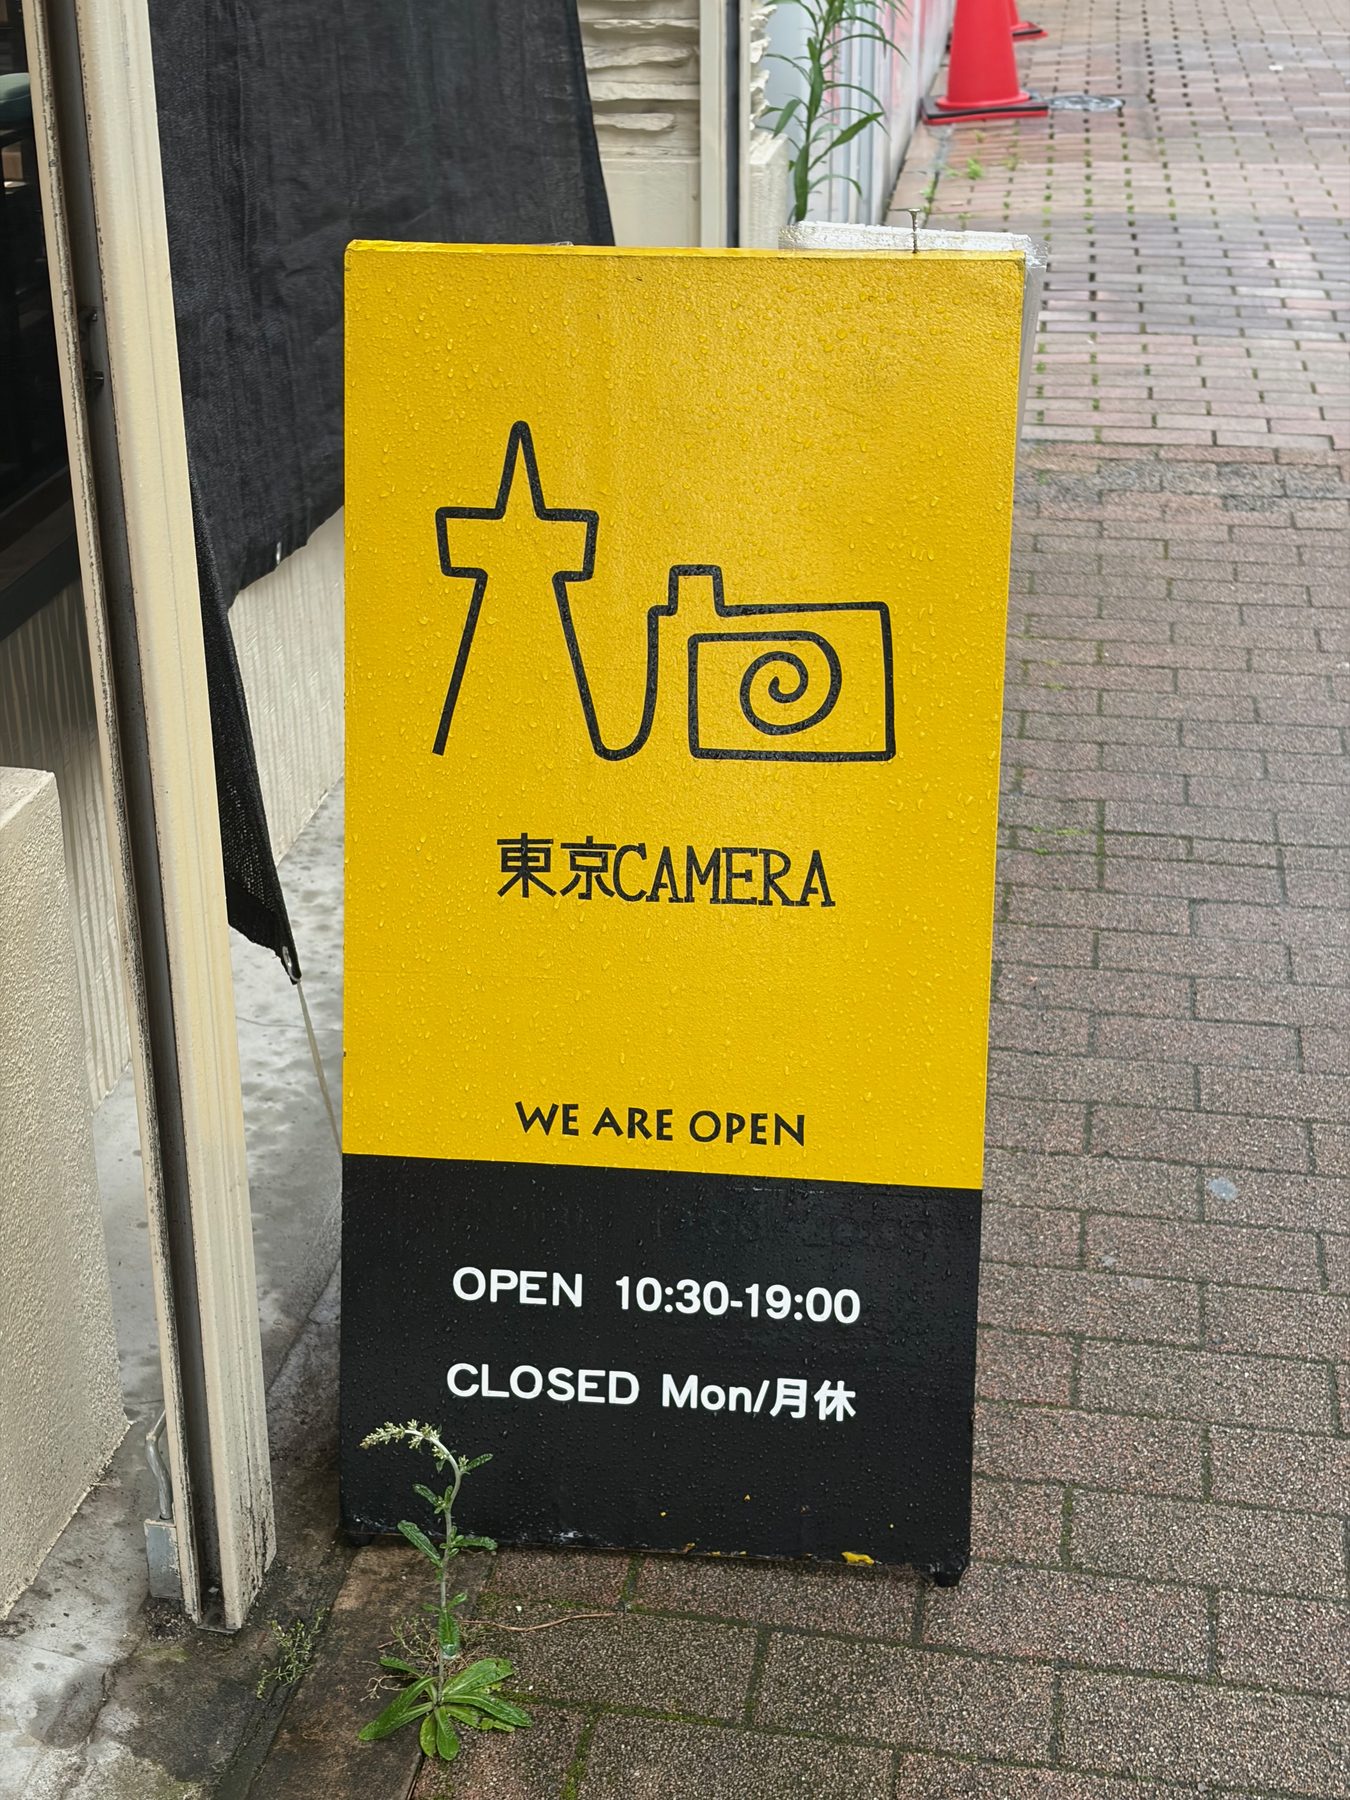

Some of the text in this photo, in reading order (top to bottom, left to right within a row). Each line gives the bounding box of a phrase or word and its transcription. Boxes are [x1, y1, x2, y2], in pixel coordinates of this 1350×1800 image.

[496, 832, 836, 908] 東京CAMERA
[514, 1101, 805, 1147] WE ARE OPEN
[452, 1266, 861, 1324] OPEN 10:30-19:00
[446, 1362, 857, 1422] CLOSED Mon/月休
